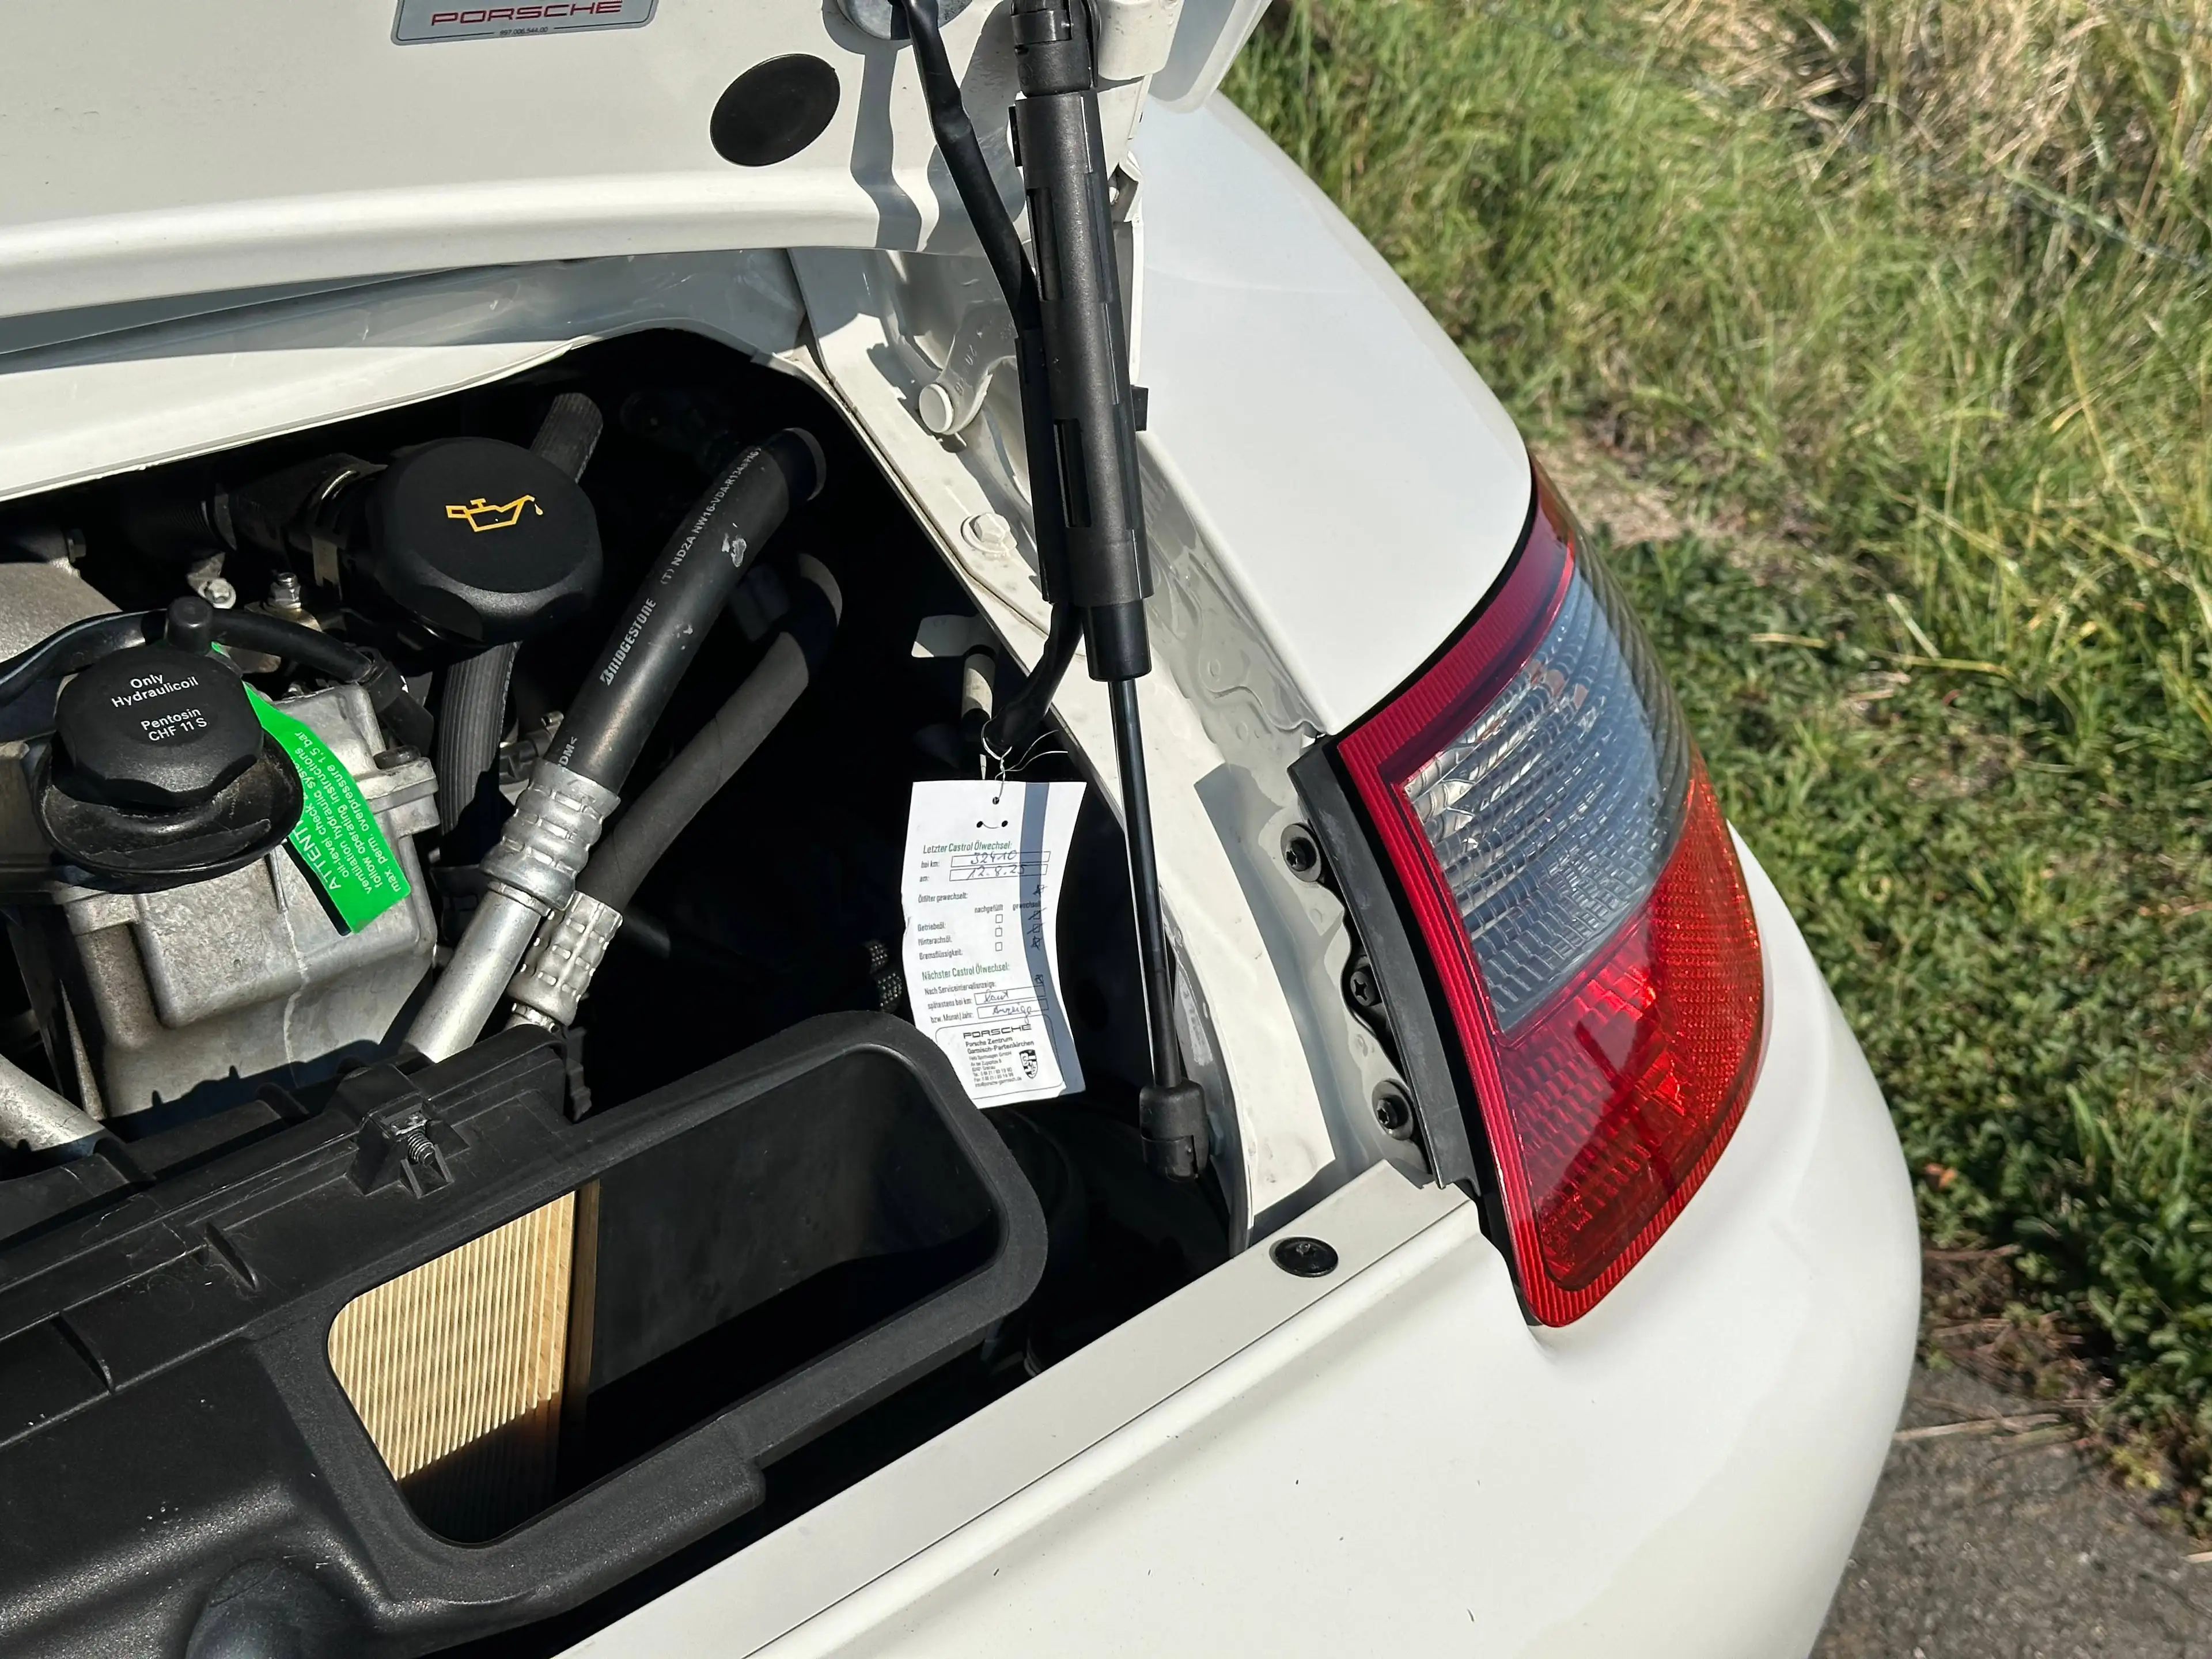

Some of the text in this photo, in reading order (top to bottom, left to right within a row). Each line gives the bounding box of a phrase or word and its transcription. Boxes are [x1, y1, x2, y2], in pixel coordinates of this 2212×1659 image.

[431, 1, 623, 26] PORSCHE
[671, 536, 696, 566] ND2A
[600, 598, 656, 685] BRIDGESTONE
[111, 676, 199, 707] Hydraulicoil
[130, 675, 163, 688] Only
[141, 709, 202, 730] Pentosin
[149, 718, 207, 741] CHF 11 S
[294, 732, 313, 748] bar
[327, 764, 369, 832] overpressure
[294, 747, 383, 888] follow operating instructions
[313, 790, 343, 840] hydraulic
[305, 802, 349, 878] oil-level check
[368, 834, 389, 864] perm.
[923, 840, 1012, 854] Letzter Castrol Ölwechsel:
[340, 840, 372, 894] ventilation
[384, 866, 402, 893] max.
[922, 962, 1010, 980] Nächster Castrol Ölwechsel:
[963, 1024, 1032, 1039] PORSCHE
